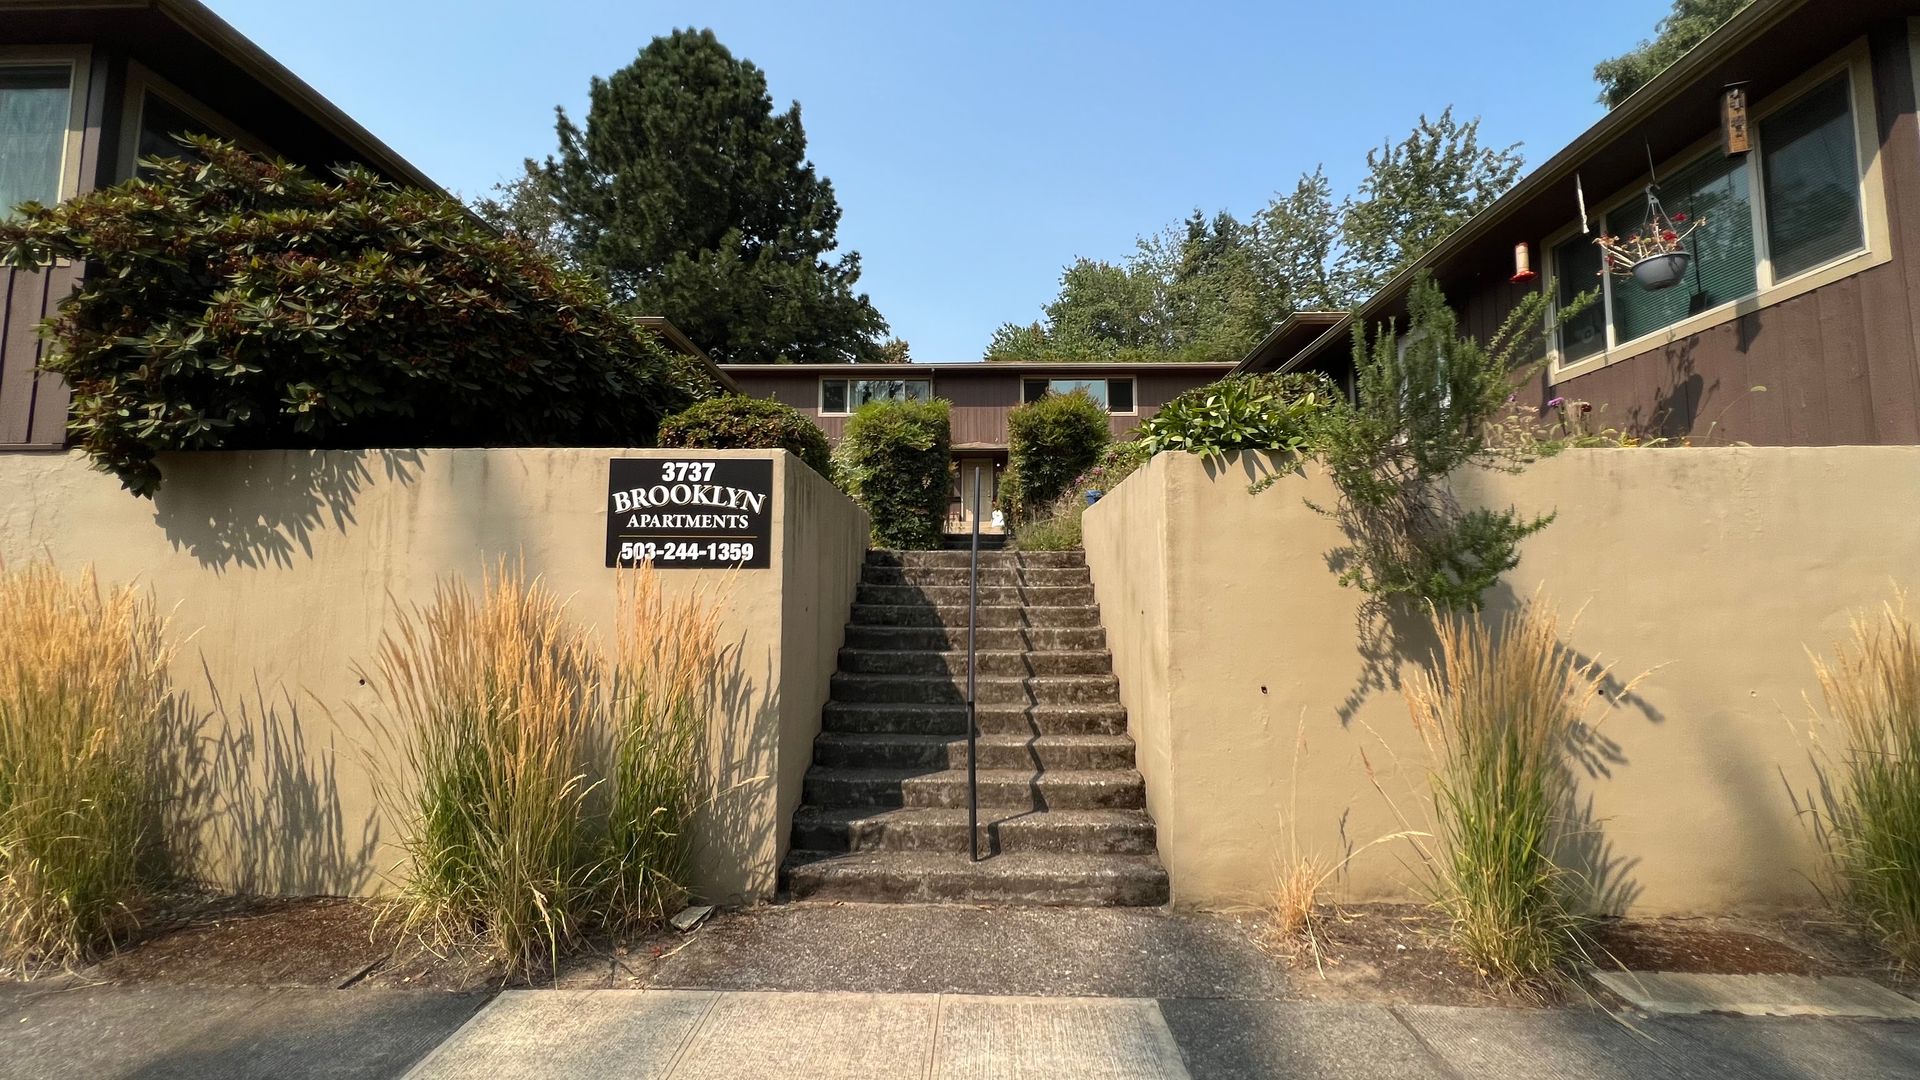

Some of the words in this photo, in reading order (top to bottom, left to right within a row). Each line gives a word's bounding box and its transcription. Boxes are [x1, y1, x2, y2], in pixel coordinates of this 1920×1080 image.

[661, 461, 716, 482] 3737
[612, 484, 767, 515] BROOKLYN
[626, 514, 749, 529] APARTMENTS
[621, 542, 754, 561] 503-244-1359
